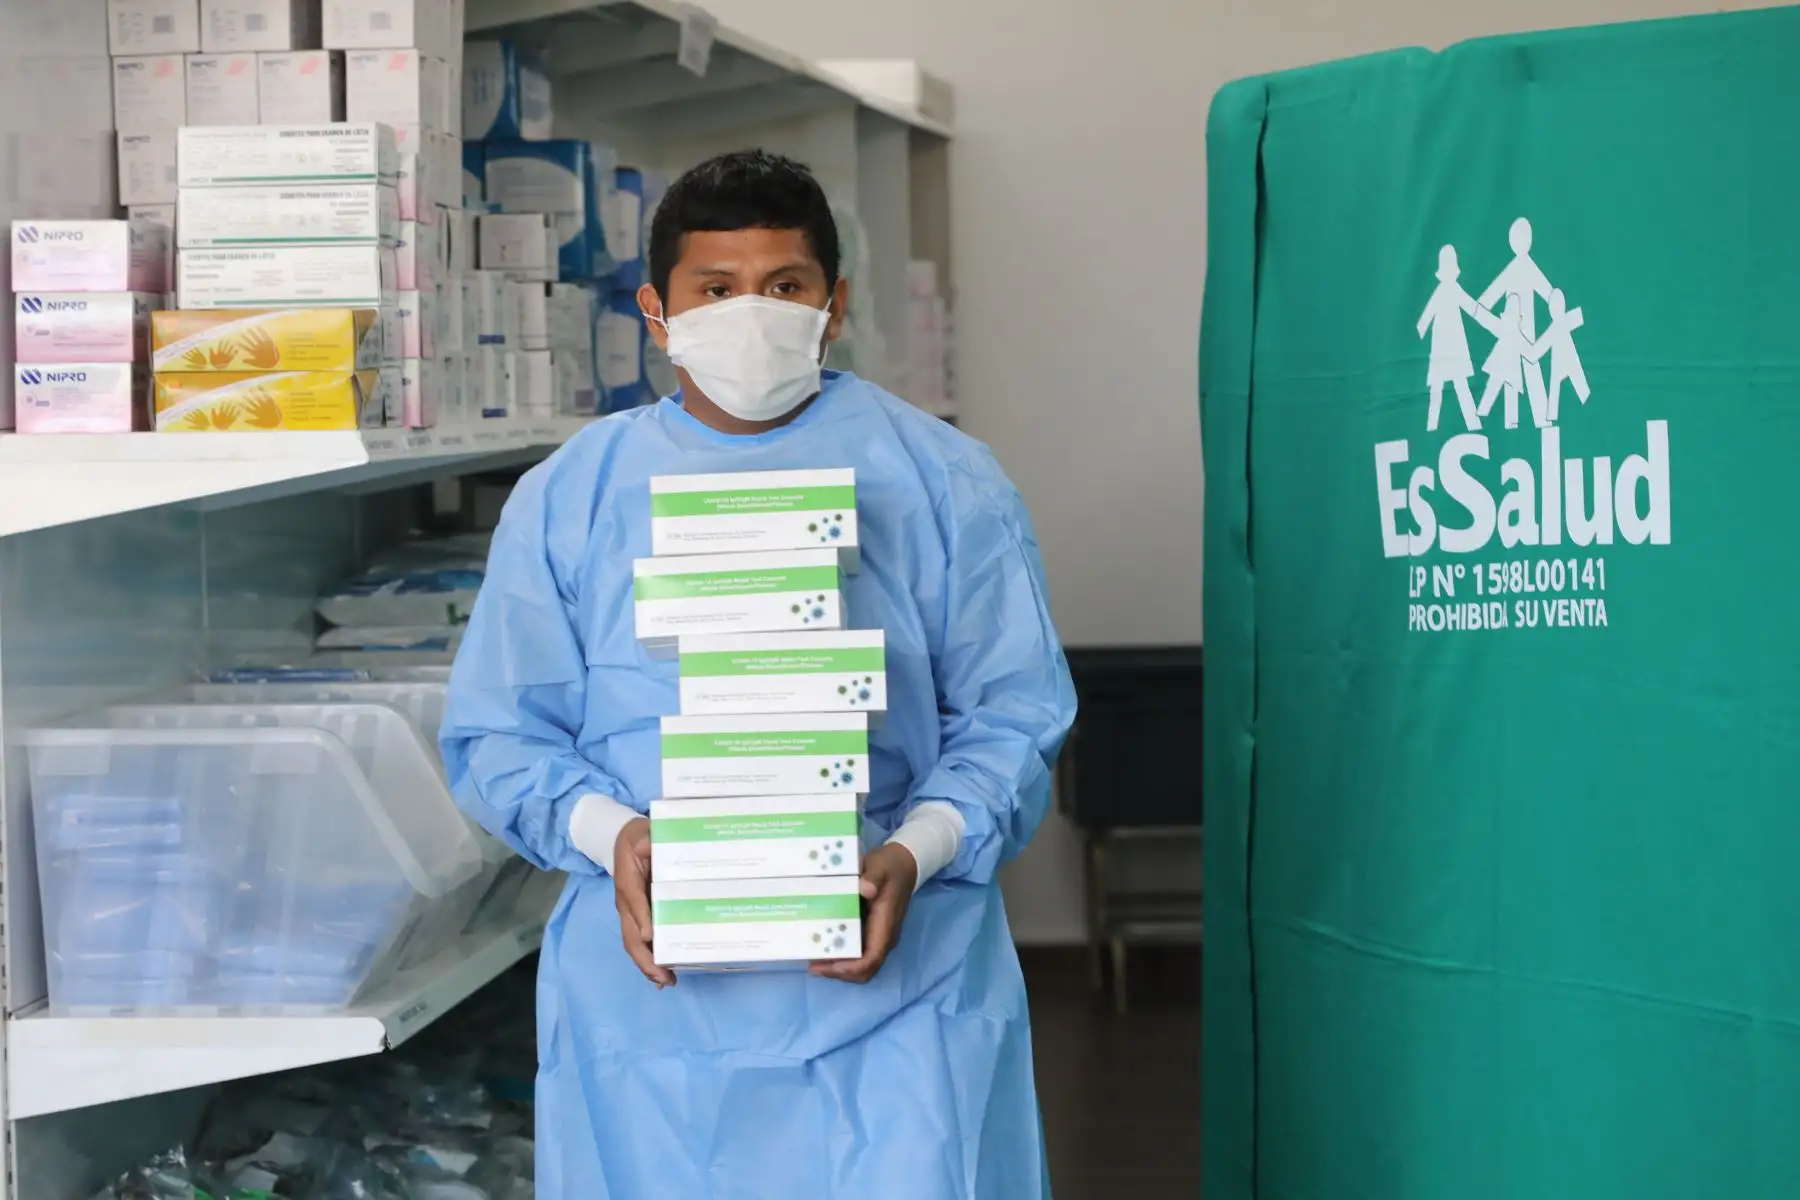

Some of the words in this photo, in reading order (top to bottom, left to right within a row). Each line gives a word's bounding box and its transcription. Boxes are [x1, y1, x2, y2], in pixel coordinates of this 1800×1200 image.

[43, 231, 84, 242] NIPRO
[47, 301, 88, 311] NIPRO
[46, 372, 87, 382] NIPRO
[1374, 419, 1671, 558] EsSalud
[1409, 565, 1427, 598] LP
[1472, 557, 1606, 596] 1598L00141
[1409, 600, 1509, 632] PROHIBIDA
[1514, 599, 1539, 628] SU
[1541, 598, 1609, 627] VENTA
